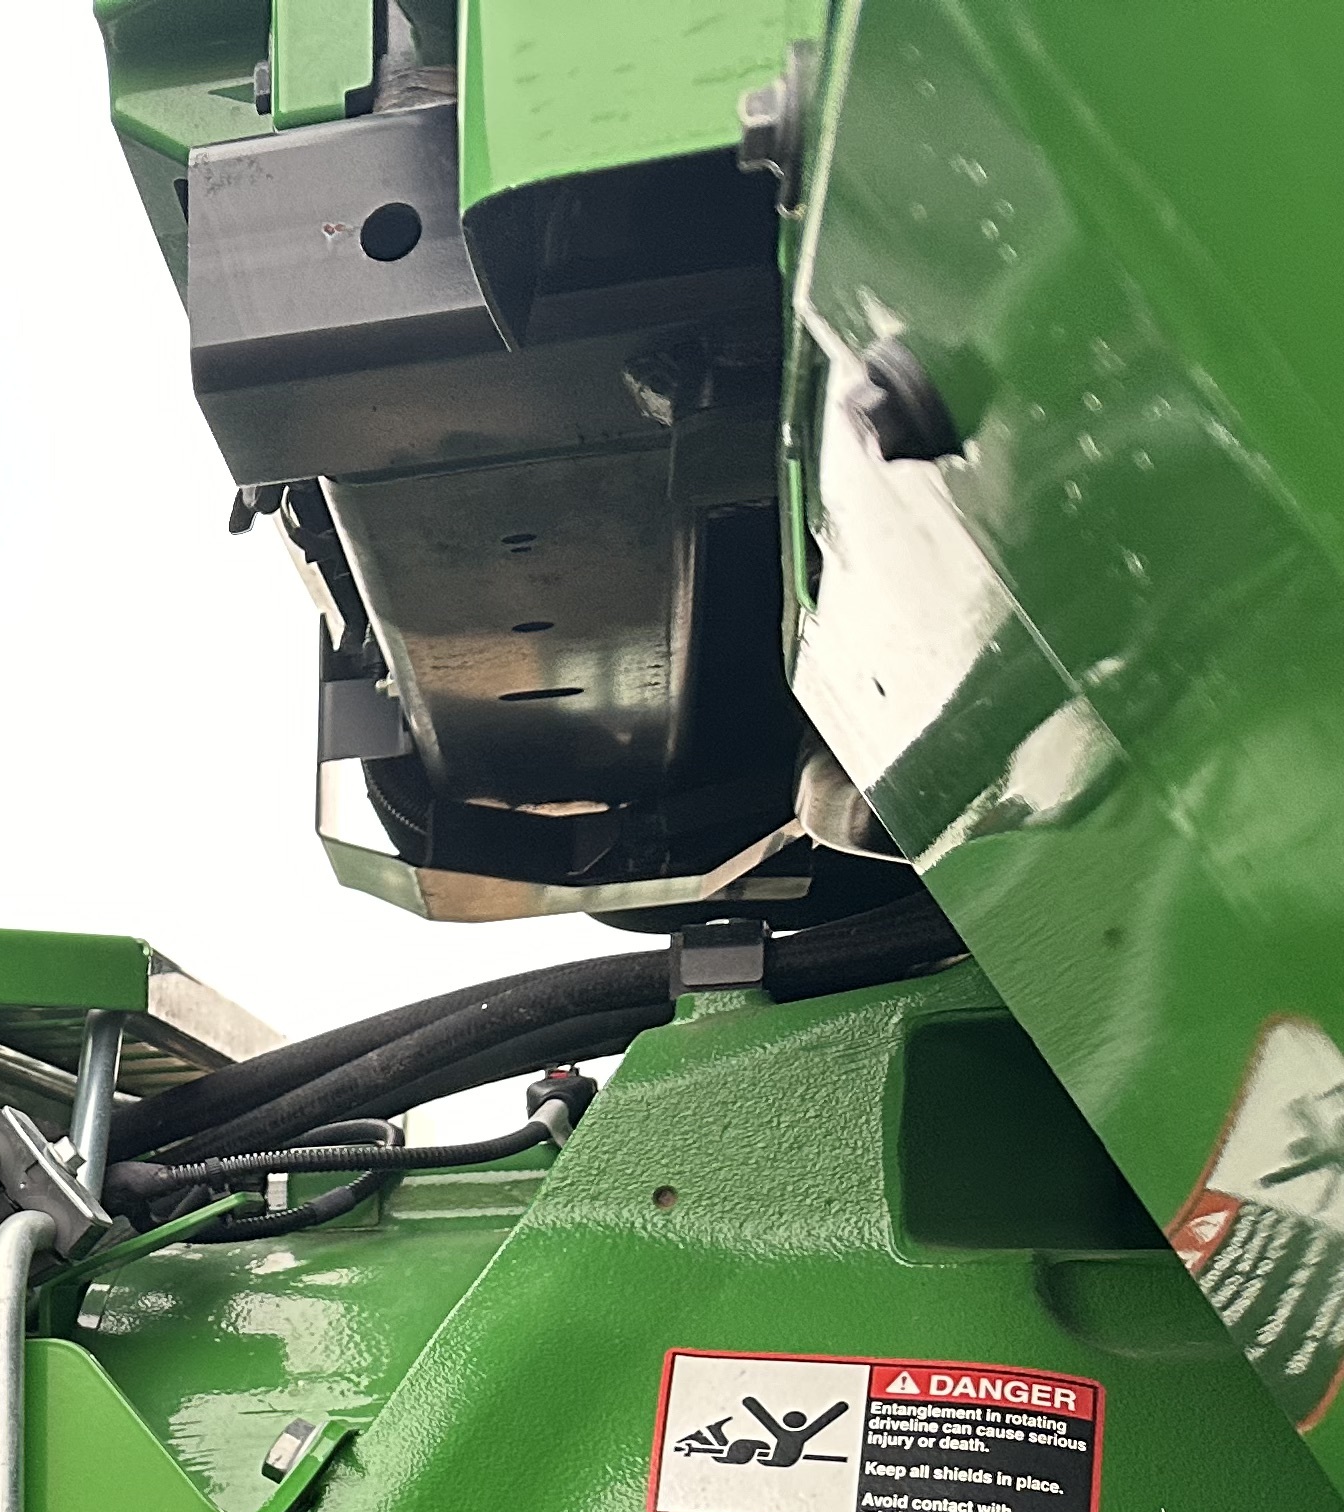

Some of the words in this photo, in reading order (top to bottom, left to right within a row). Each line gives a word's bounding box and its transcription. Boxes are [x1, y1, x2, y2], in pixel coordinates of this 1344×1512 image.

[929, 1374, 1077, 1412] DANGER
[868, 1417, 939, 1433] driveline
[942, 1422, 972, 1436] can
[976, 1425, 1025, 1441] cause
[1028, 1431, 1087, 1451] serious
[870, 1402, 982, 1421] Entanglement
[985, 1408, 1001, 1423] in
[1005, 1413, 1067, 1435] rotating
[866, 1432, 914, 1450] injury
[917, 1437, 937, 1448] or
[939, 1436, 990, 1453] death.
[864, 1461, 907, 1480] Keep
[909, 1464, 930, 1479] all
[932, 1466, 992, 1484] shields
[996, 1471, 1012, 1486] in
[1015, 1475, 1064, 1494] place.
[861, 1493, 909, 1509] Avoid
